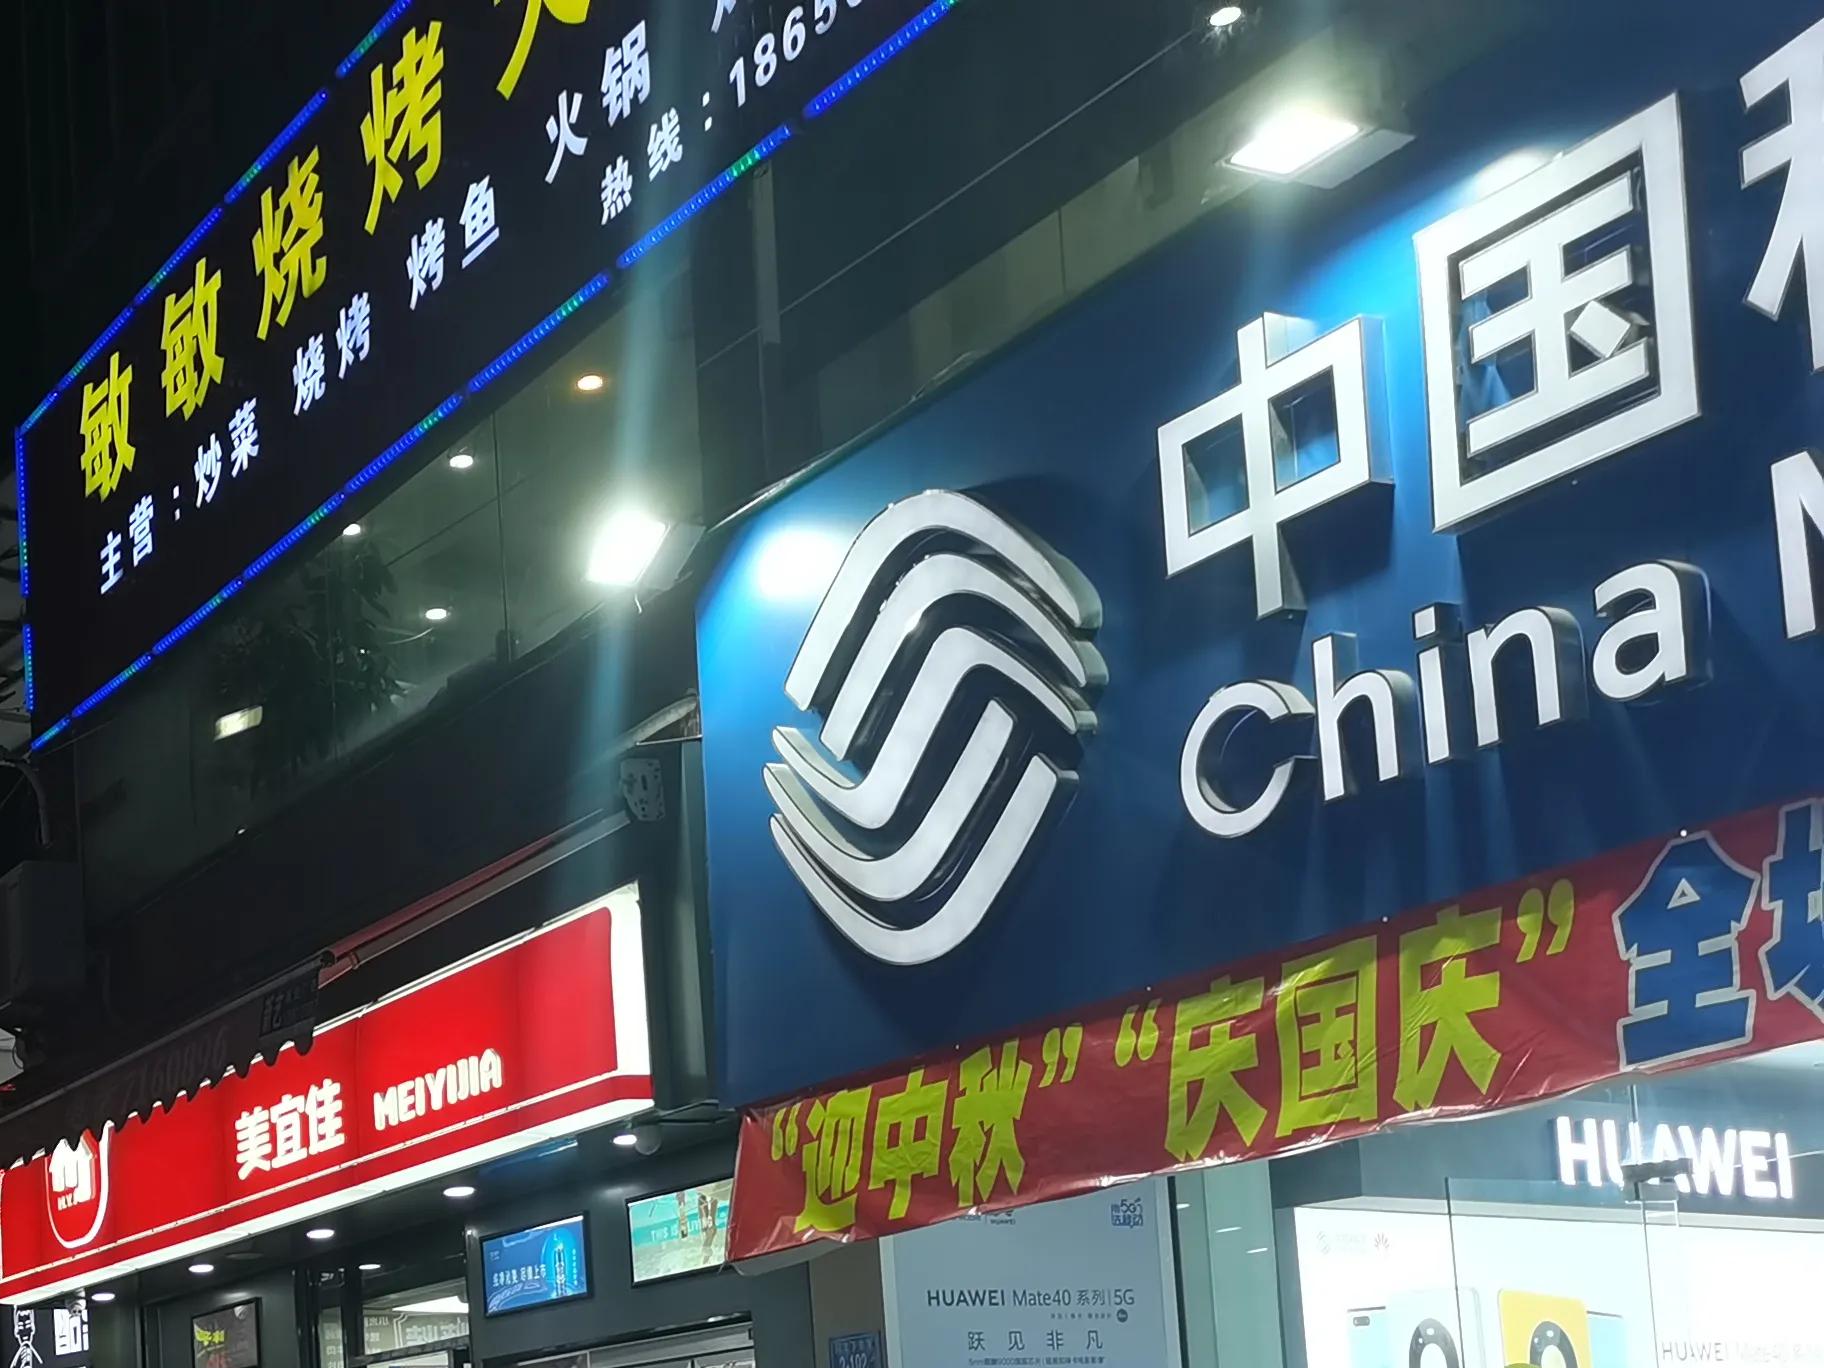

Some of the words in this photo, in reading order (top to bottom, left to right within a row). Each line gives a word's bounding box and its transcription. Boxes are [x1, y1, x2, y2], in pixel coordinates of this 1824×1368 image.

[292, 291, 372, 414] 烧烤
[406, 175, 499, 310] 烤鱼
[545, 20, 650, 184] 火锅
[1180, 560, 1696, 838] China
[234, 1077, 346, 1181] 美宜佳
[373, 1047, 504, 1132] MEIYIJIA
[1555, 1115, 1794, 1199] HUAWEI
[927, 1289, 1005, 1307] HUAWEI
[1012, 1288, 1072, 1306] Mate40
[968, 1329, 1104, 1352] 跃见非凡
[1662, 1340, 1729, 1361] HUAWEI
